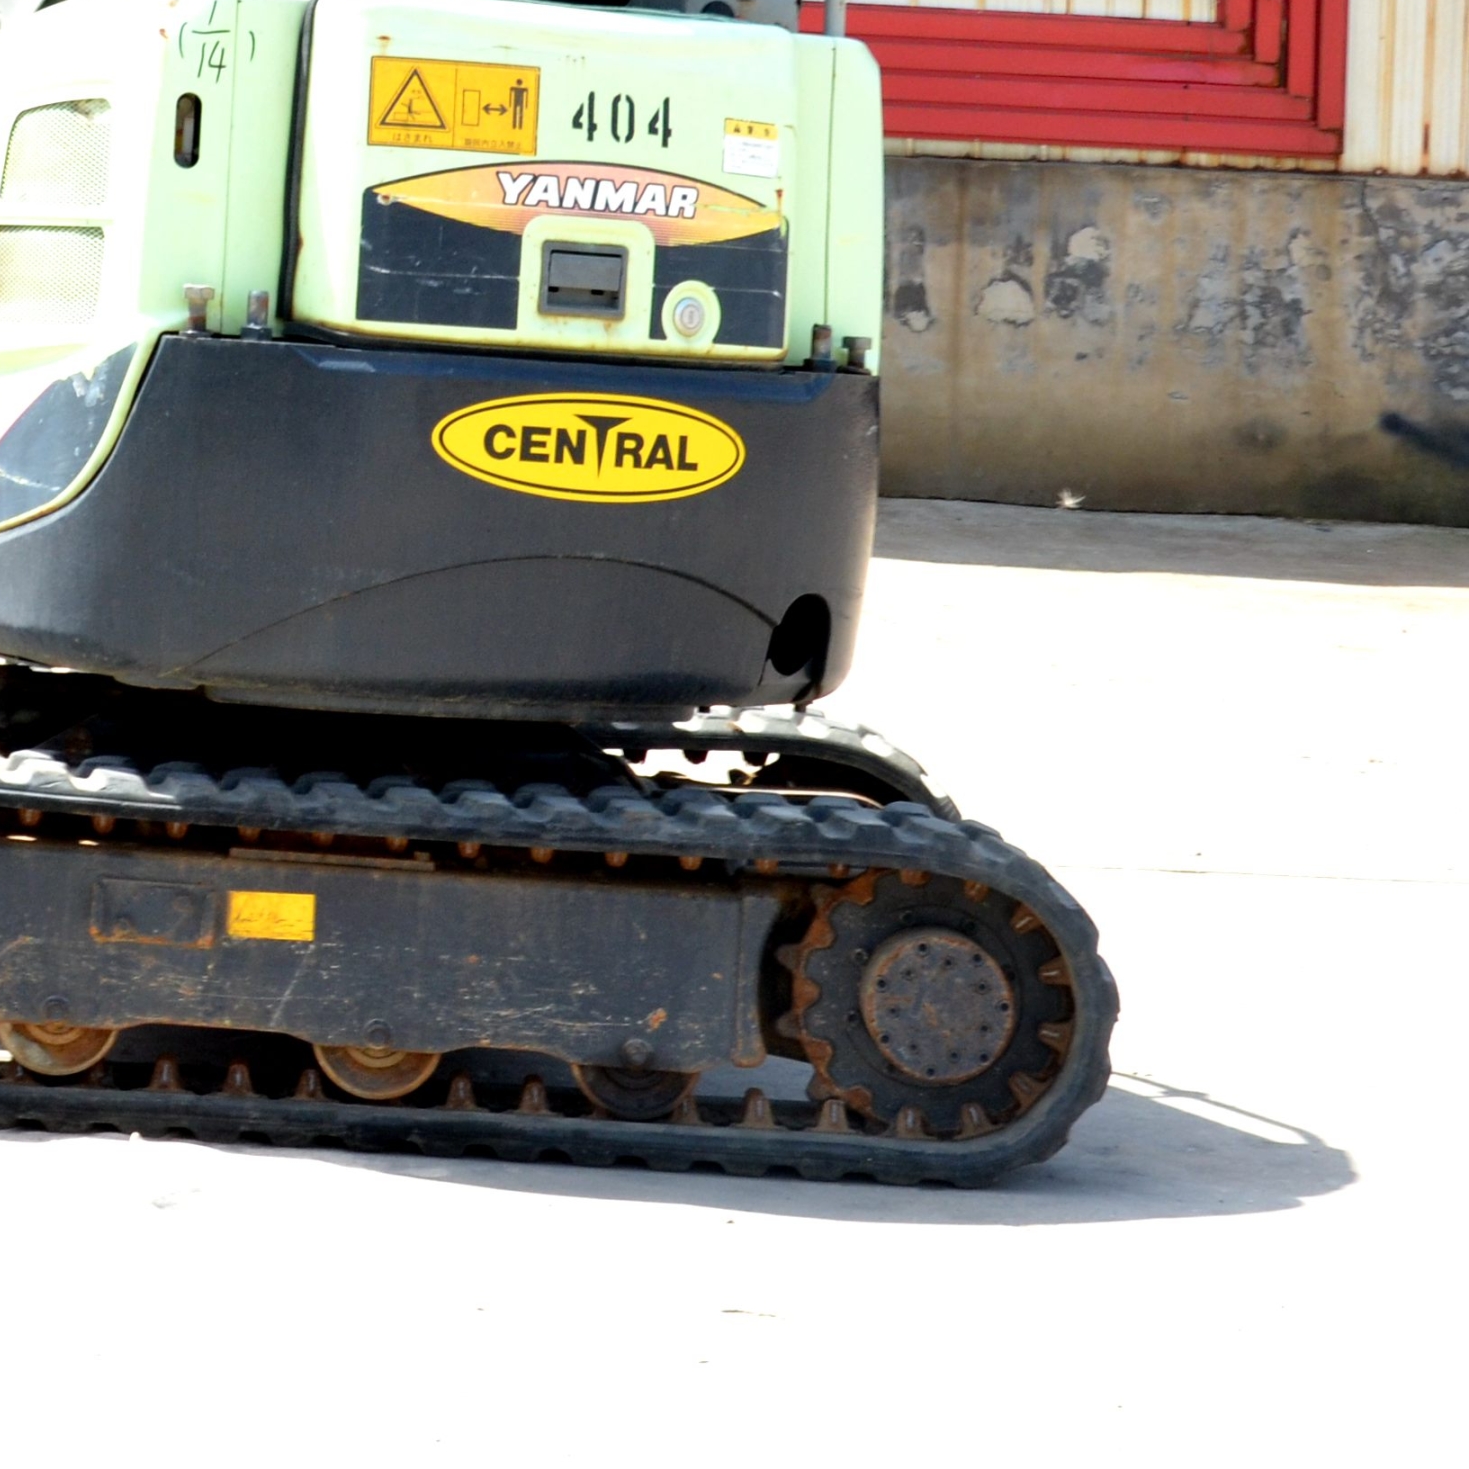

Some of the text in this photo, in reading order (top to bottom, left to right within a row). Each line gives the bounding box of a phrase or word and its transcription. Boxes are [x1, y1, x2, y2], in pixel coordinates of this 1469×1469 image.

[572, 90, 673, 148] 404
[496, 170, 700, 219] YANMAR
[483, 414, 698, 478] CENTRAL
